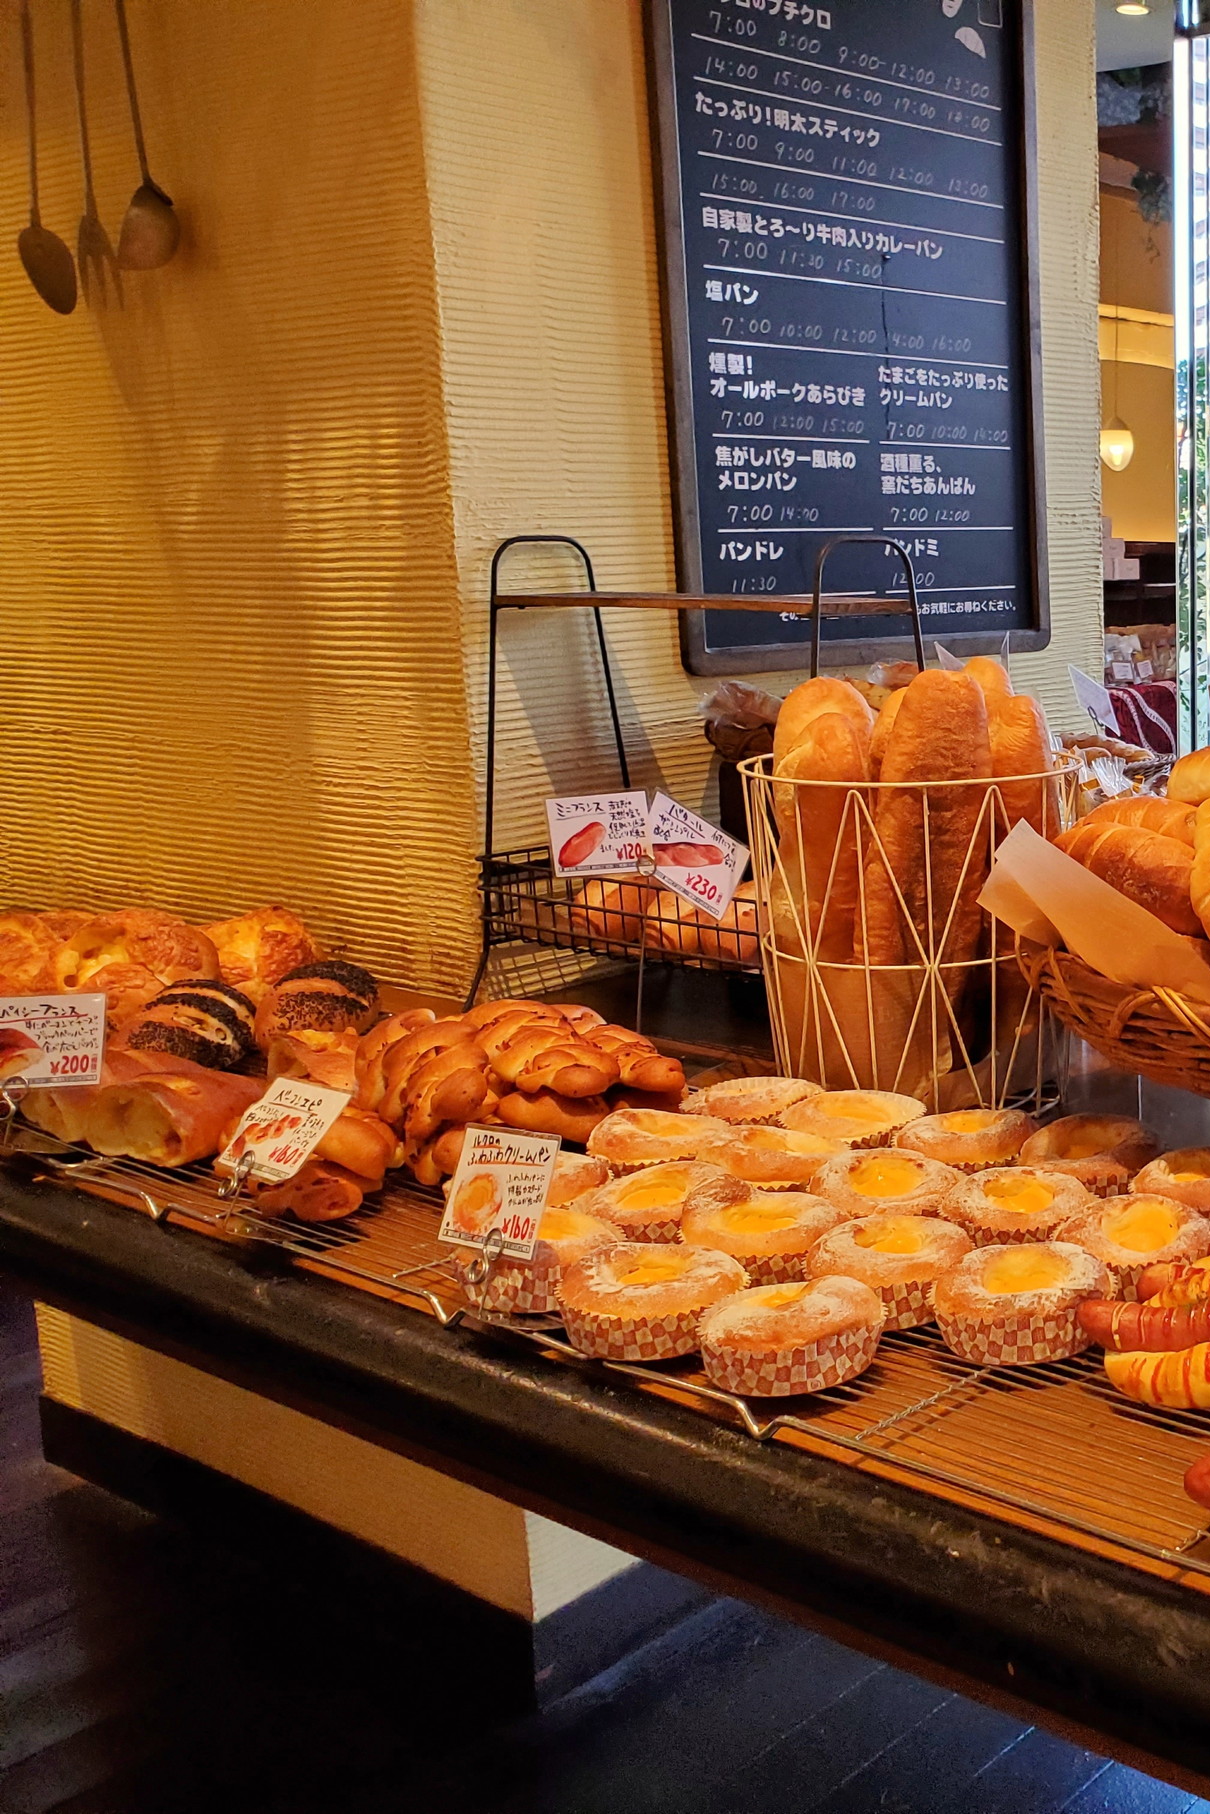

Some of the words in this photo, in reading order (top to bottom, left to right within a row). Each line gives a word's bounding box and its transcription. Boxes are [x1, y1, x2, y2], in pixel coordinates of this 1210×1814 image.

[709, 10, 757, 36] 7:00
[777, 30, 821, 54] 8:00
[705, 56, 758, 80] 14:00
[711, 128, 758, 151] 7:00
[774, 141, 814, 163] 9:00
[832, 154, 877, 177] 11:00
[711, 172, 758, 194] 15:00
[773, 181, 815, 201] 16:00
[831, 190, 876, 212] 17:00
[717, 238, 768, 260] 7:00
[836, 257, 882, 279] 15:00
[705, 280, 759, 305] 塩パン
[721, 317, 771, 336] 7:00
[779, 323, 823, 341] 10:00
[833, 327, 877, 345] 12:00
[887, 332, 924, 350] 4:00
[878, 365, 1008, 392] たまごをたっぷり使った
[710, 378, 865, 407] オールポークあらびき
[880, 390, 952, 409] クリームパン
[721, 410, 764, 428] 7:00
[886, 421, 925, 439] 7:00
[715, 445, 856, 470] 焦がしバター風味の
[717, 470, 798, 491] メロンパン
[727, 504, 773, 523] 7:00
[891, 506, 928, 523] 7:00
[934, 509, 971, 523] 12:00
[719, 541, 784, 561] パンドレ
[732, 575, 777, 592] 11:30
[616, 843, 642, 861] ¥120
[685, 872, 718, 901] ¥230
[50, 1054, 90, 1075] ¥200
[501, 1215, 530, 1241] ¥160
